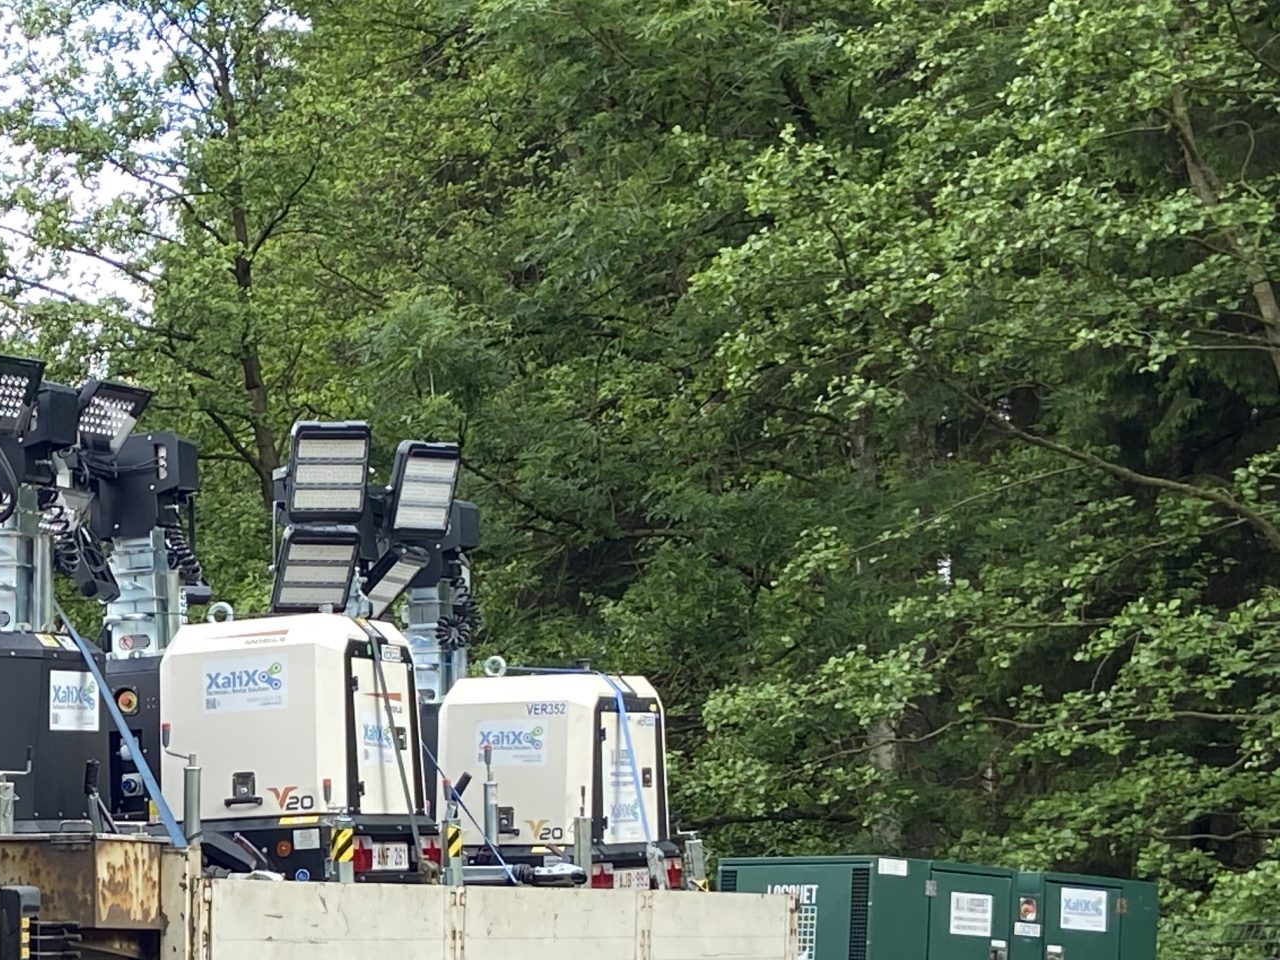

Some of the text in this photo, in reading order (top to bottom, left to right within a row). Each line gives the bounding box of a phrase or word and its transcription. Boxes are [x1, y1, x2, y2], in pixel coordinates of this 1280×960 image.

[206, 669, 259, 689] XaliX
[52, 685, 83, 704] XaliX
[526, 703, 566, 715] VER352
[479, 731, 523, 745] XaliX
[266, 786, 314, 811] V20
[524, 819, 563, 841] V20
